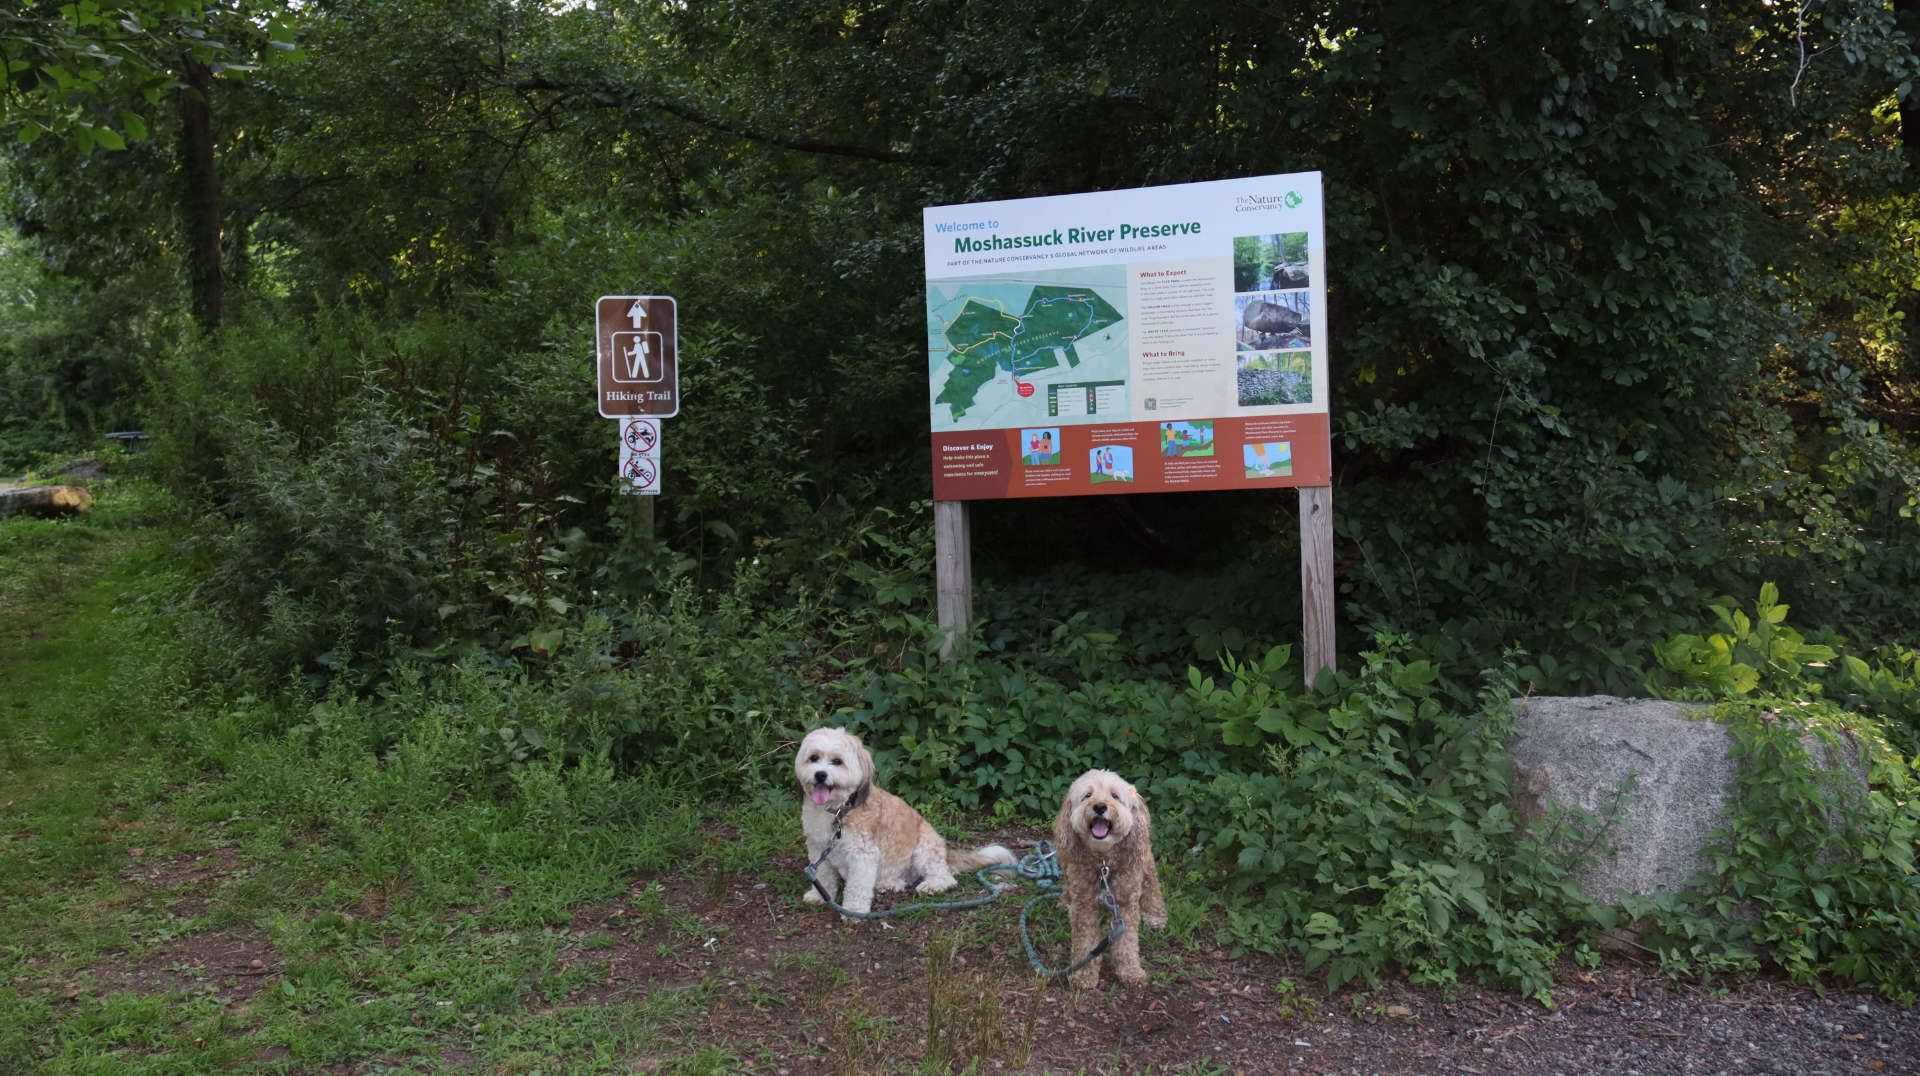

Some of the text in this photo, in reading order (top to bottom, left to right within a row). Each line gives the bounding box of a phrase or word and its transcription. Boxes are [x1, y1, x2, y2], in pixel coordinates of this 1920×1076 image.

[1249, 195, 1282, 204] Nature
[1235, 203, 1282, 212] Conservancy
[935, 219, 999, 233] Welcome to
[954, 222, 1201, 254] Moshassuck River Preserve
[1055, 251, 1078, 259] GLOBAL
[1166, 269, 1187, 277] Expect
[606, 391, 671, 403] Hiking Trail
[976, 443, 994, 451] Enjoy
